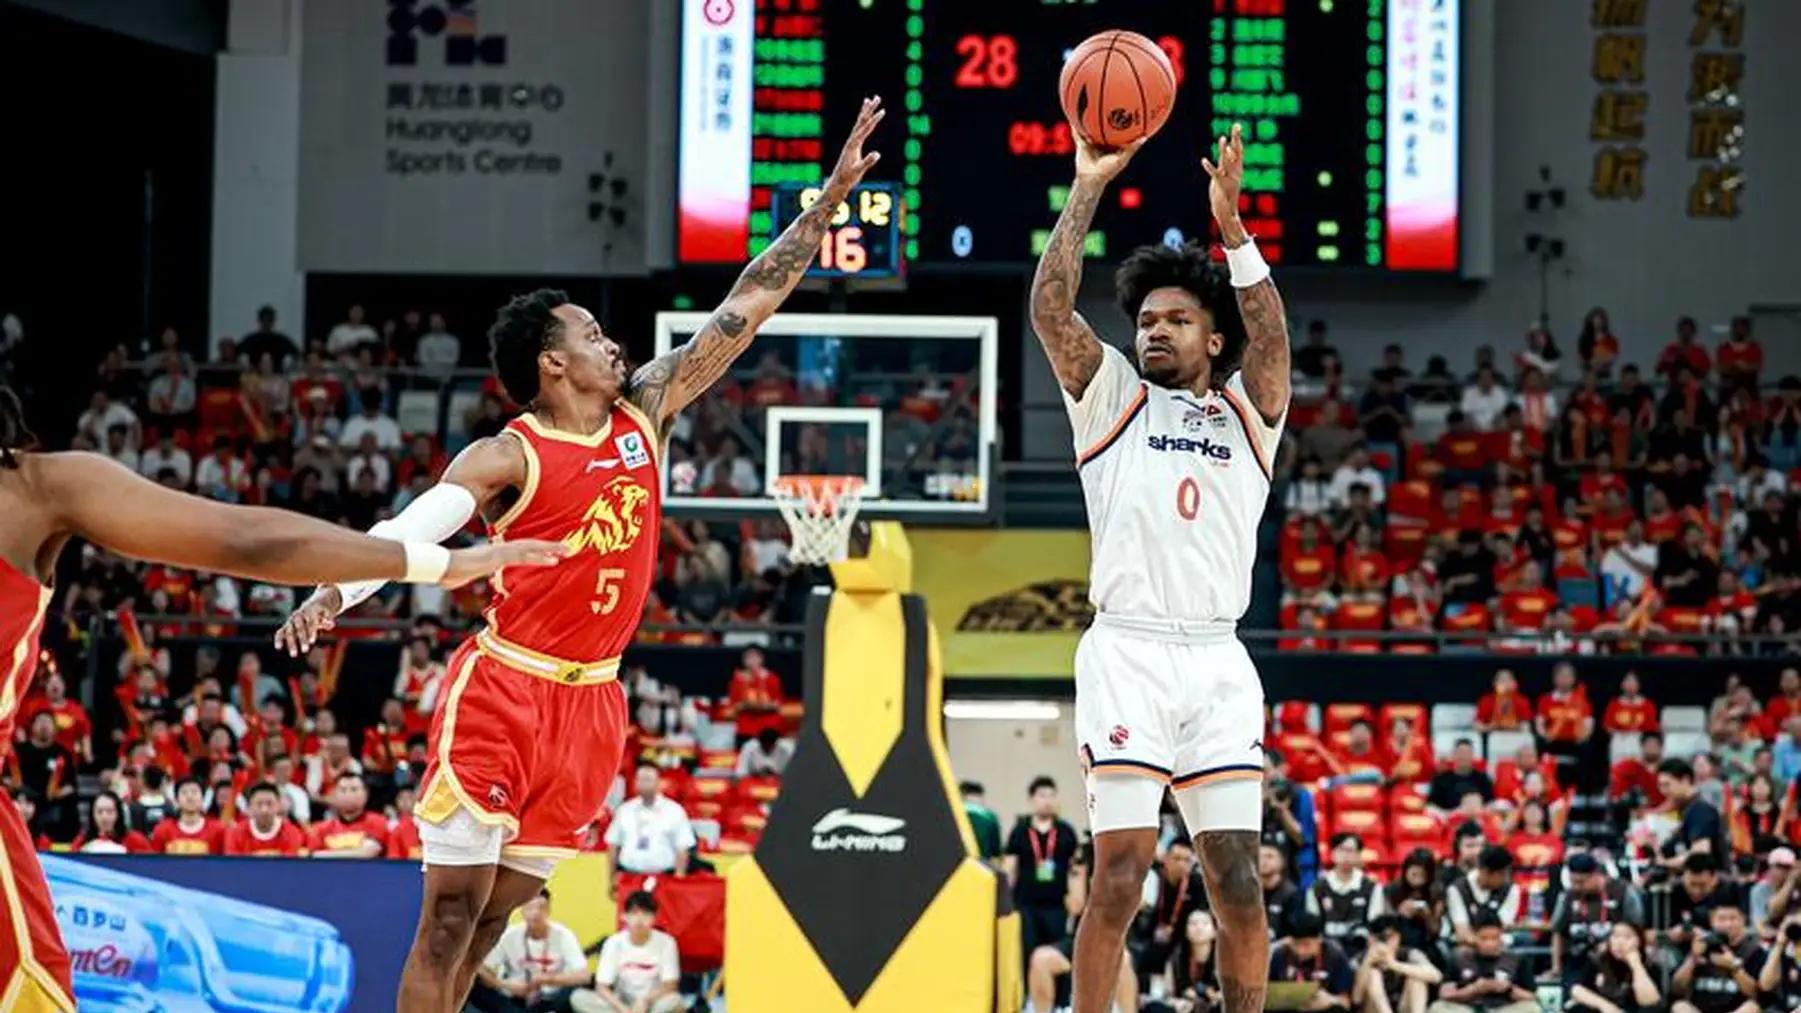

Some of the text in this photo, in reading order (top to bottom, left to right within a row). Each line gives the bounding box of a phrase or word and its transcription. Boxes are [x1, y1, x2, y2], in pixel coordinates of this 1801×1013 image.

[956, 35, 1018, 88] 28
[386, 117, 532, 146] Huanglong
[1009, 121, 1073, 155] 09:5
[386, 149, 562, 174] Sports Centre
[820, 227, 866, 272] 16
[952, 225, 973, 257] 0
[1148, 434, 1232, 460] sharks
[1177, 477, 1200, 521] 0
[590, 568, 626, 616] 5
